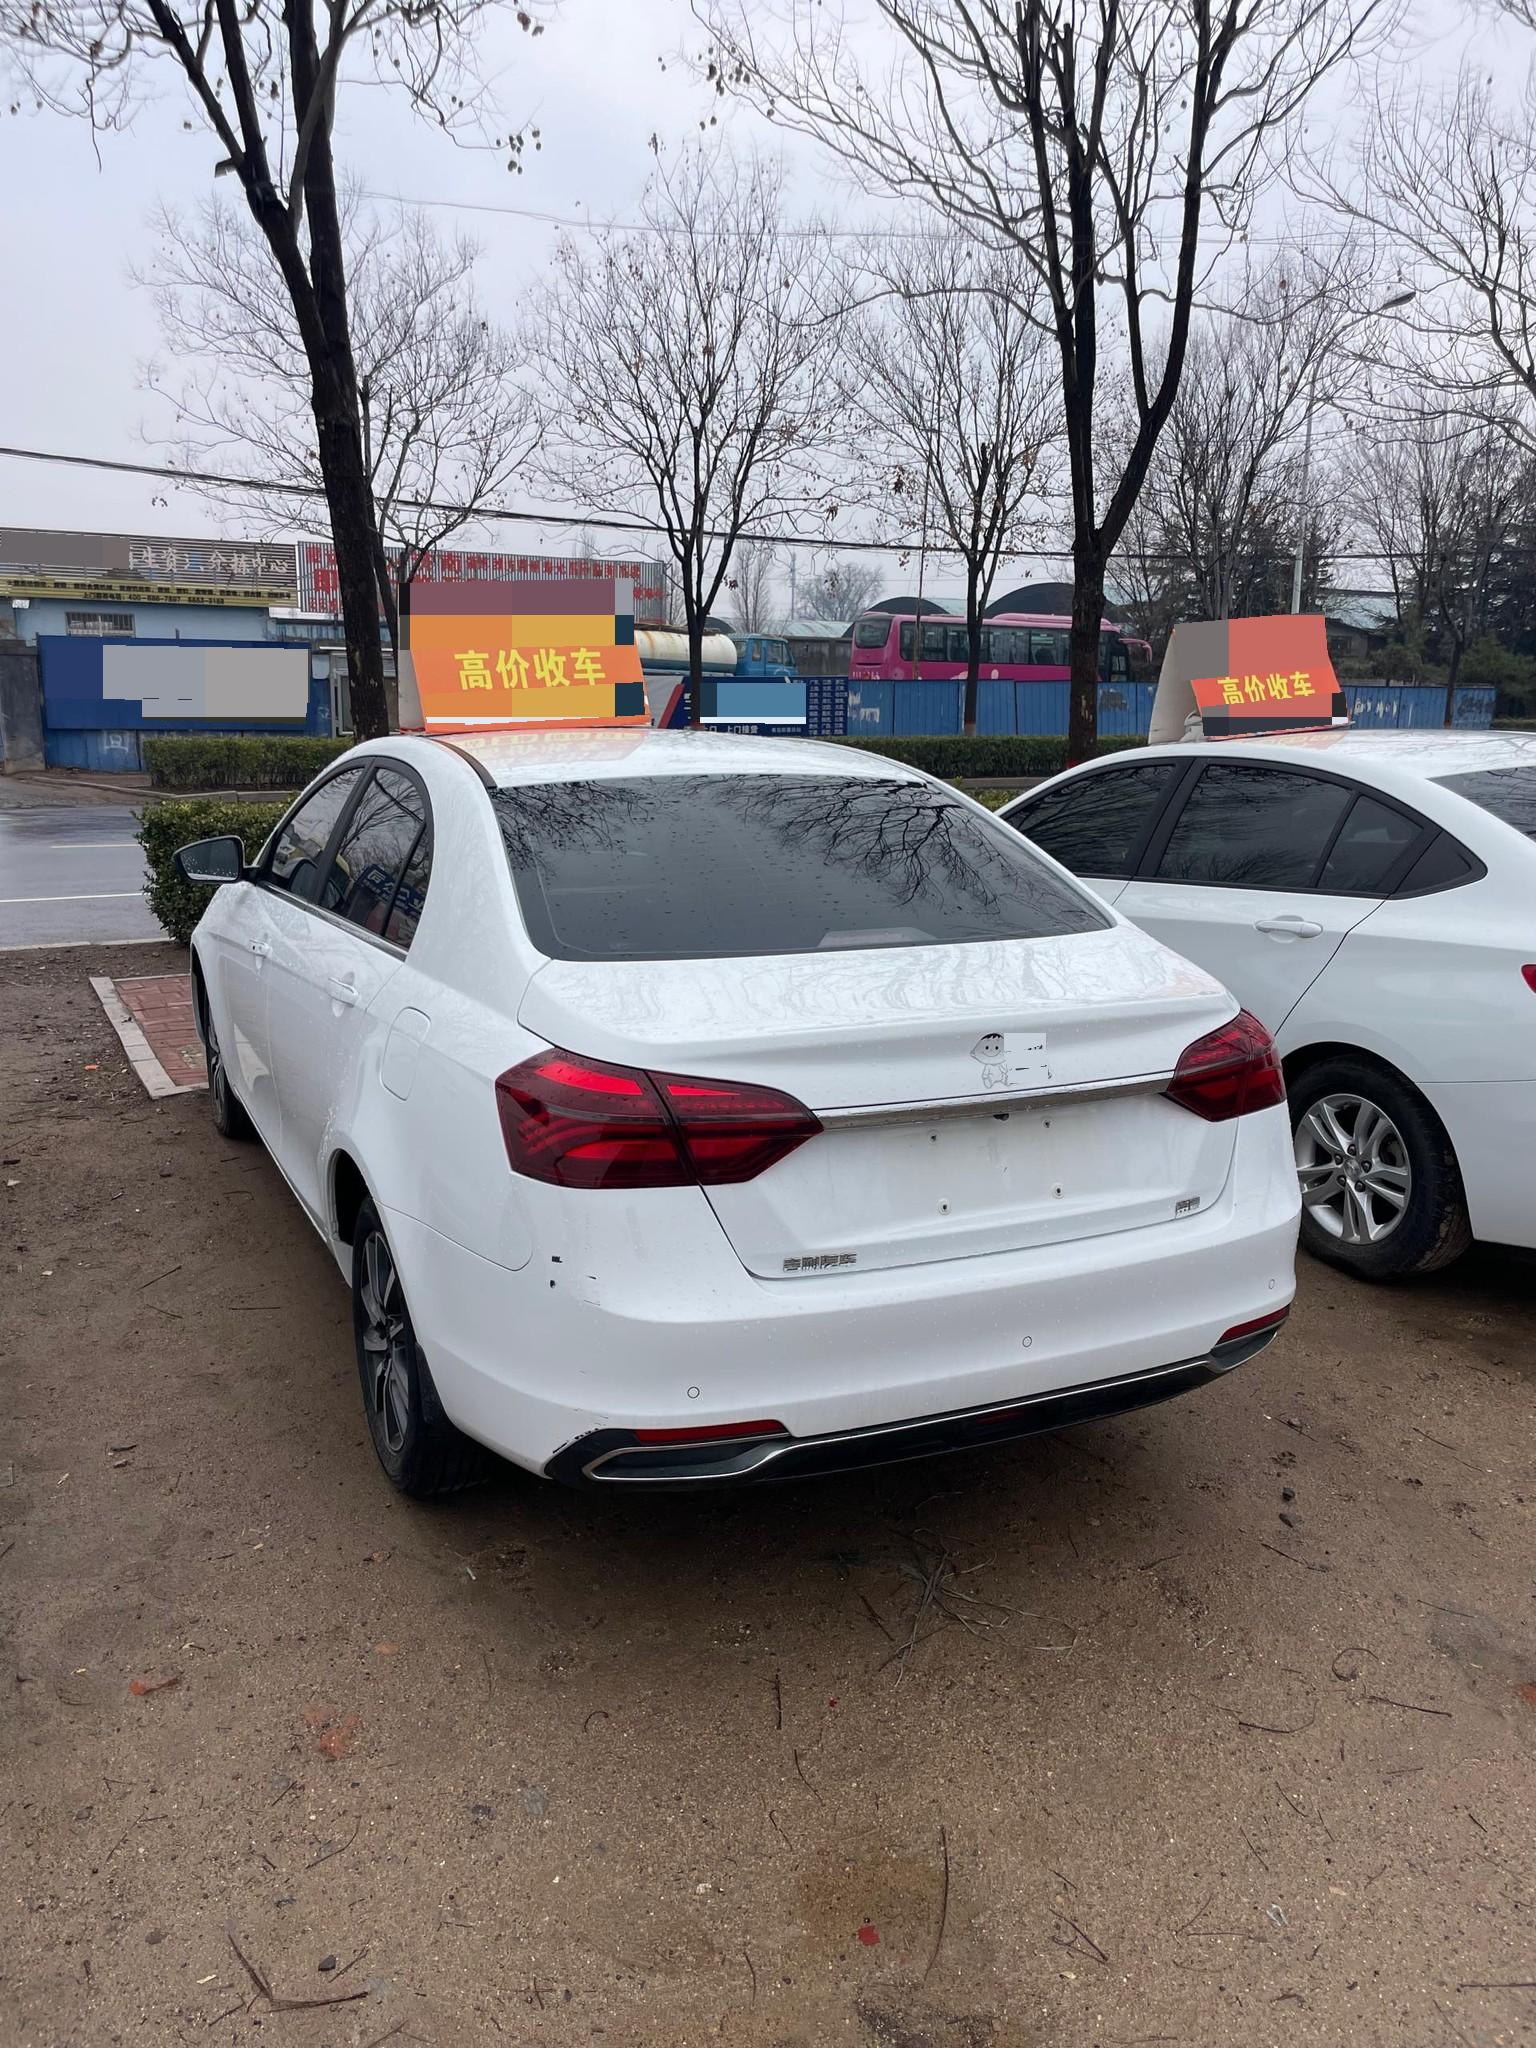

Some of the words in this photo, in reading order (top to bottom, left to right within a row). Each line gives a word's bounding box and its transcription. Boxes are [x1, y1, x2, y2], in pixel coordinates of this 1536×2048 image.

[129, 546, 288, 577] 生资分拣中心
[454, 647, 606, 690] 高价收车
[1217, 671, 1316, 705] 高价收车
